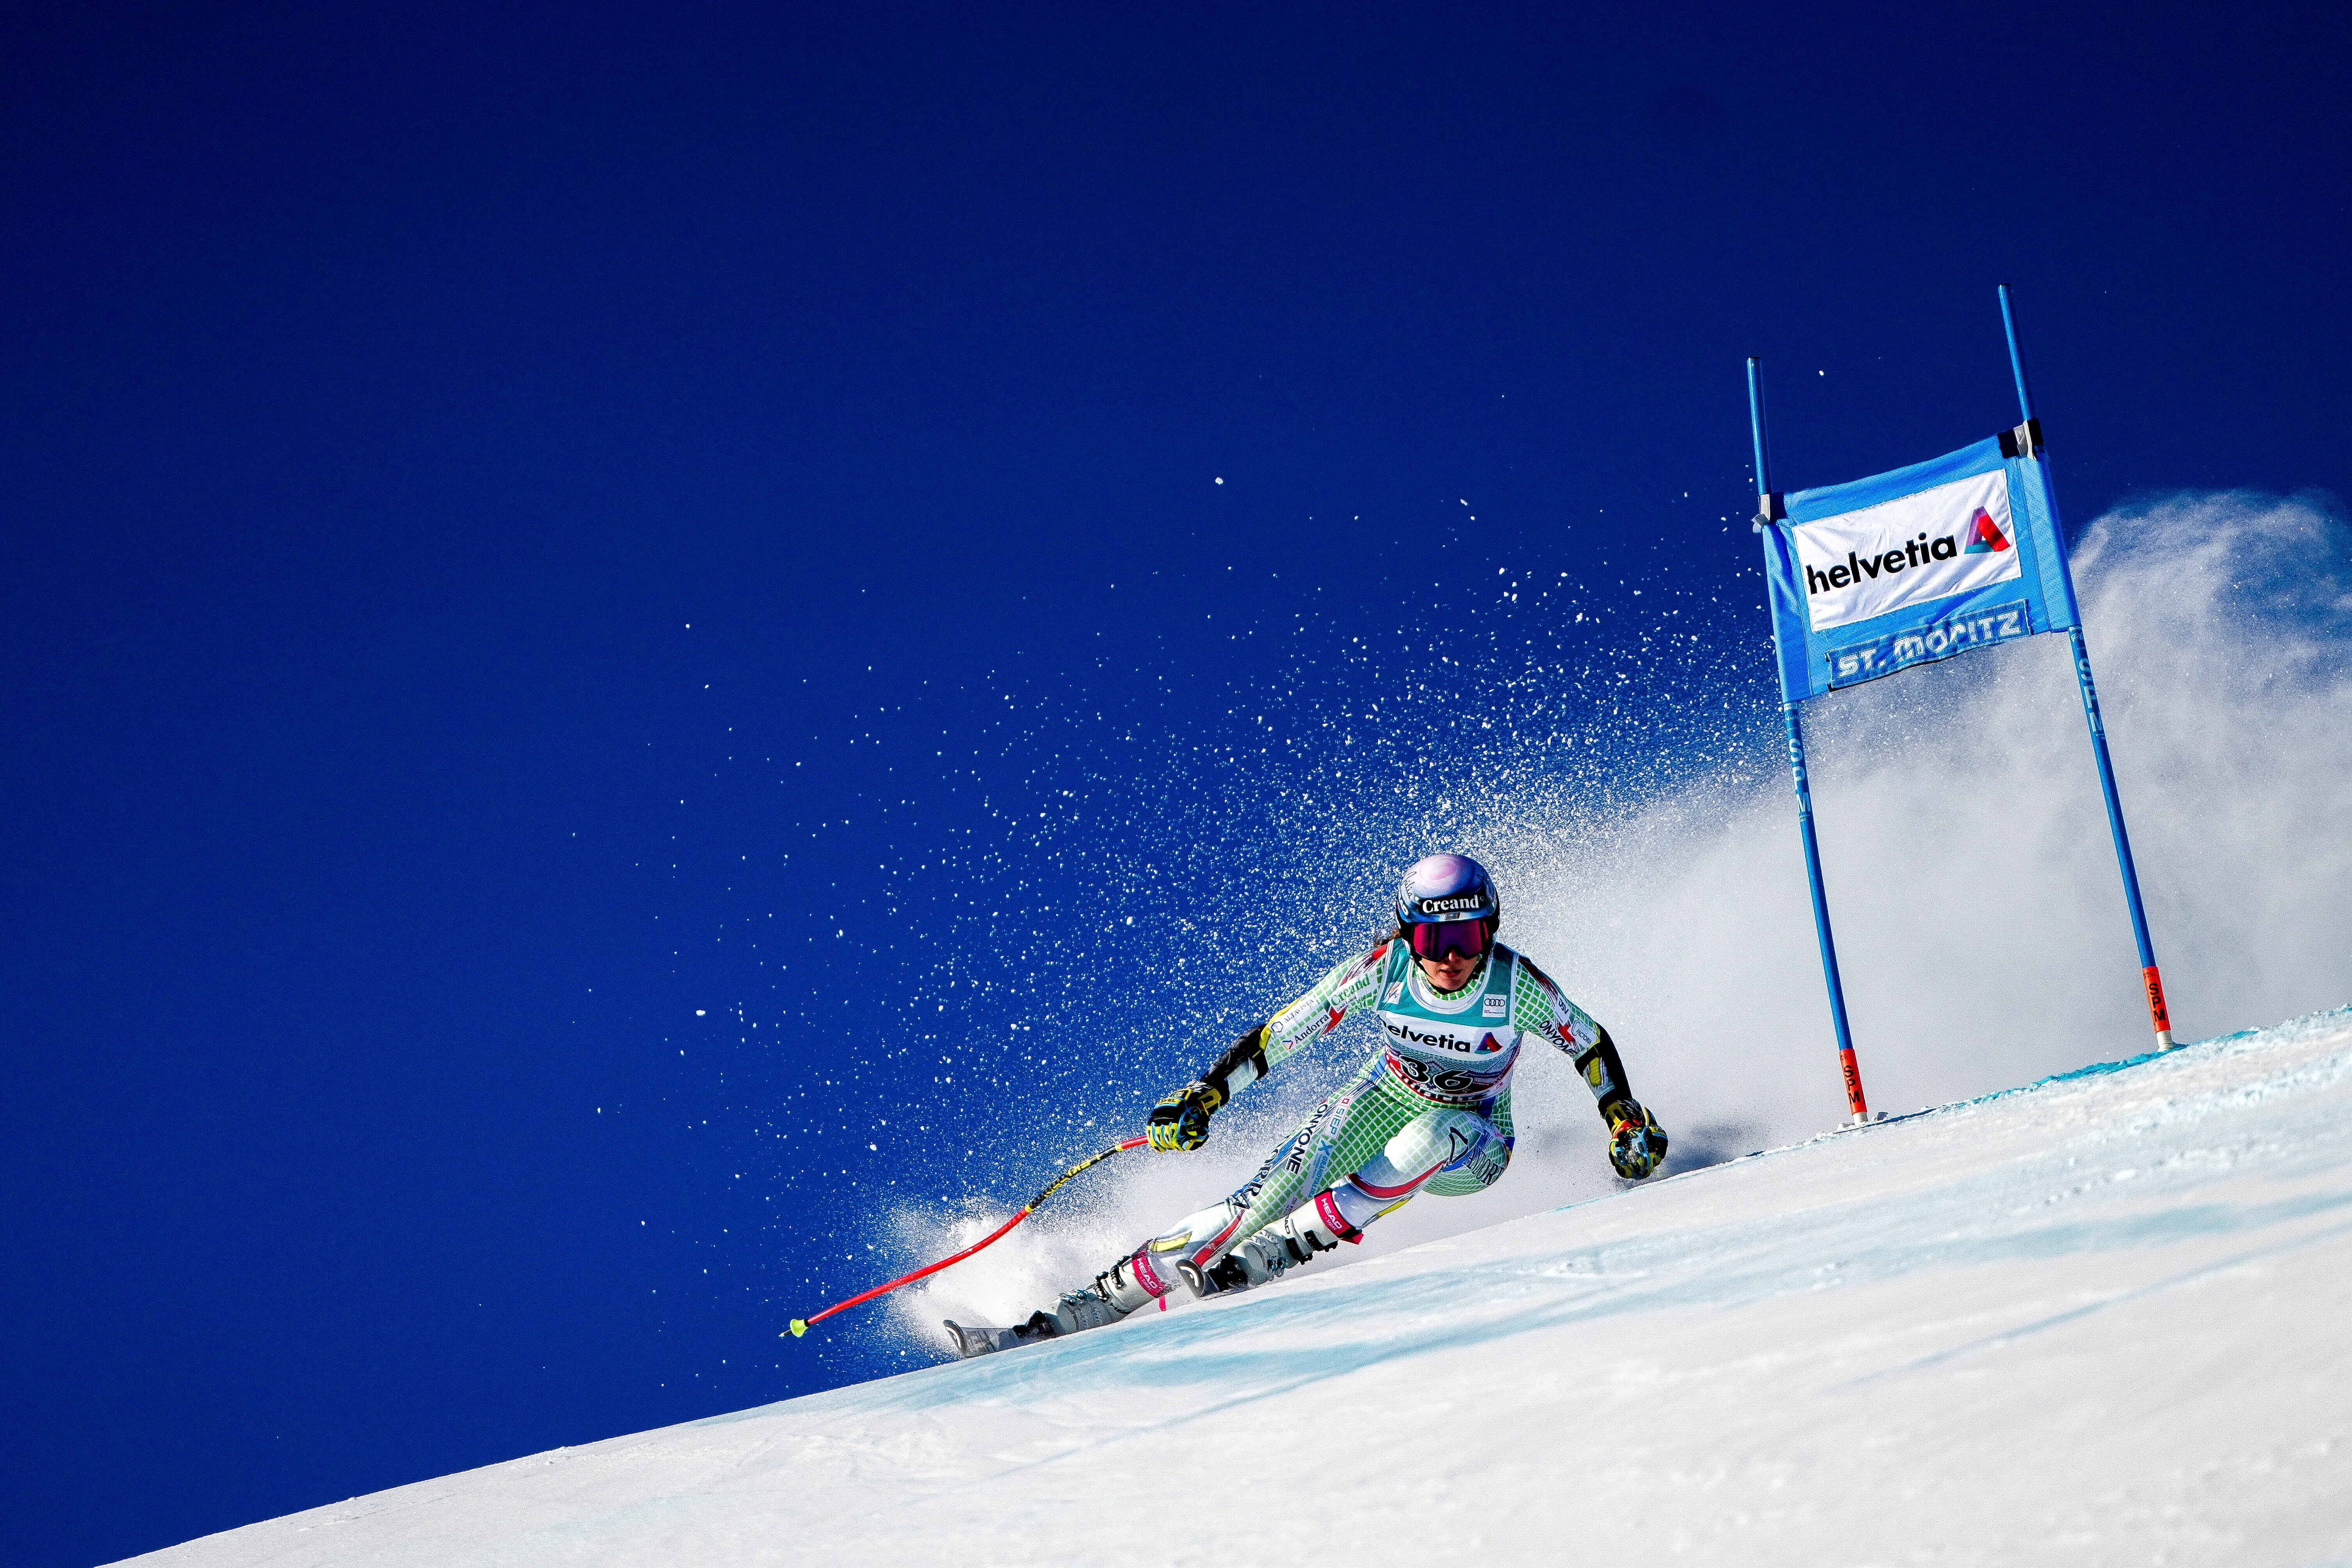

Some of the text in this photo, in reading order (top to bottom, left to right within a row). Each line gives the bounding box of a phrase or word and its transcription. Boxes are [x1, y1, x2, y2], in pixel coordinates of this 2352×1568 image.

[1806, 532, 1957, 595] helvetia
[1837, 647, 1886, 678] ST.
[1789, 738, 1811, 813] SPM
[1422, 895, 1479, 913] Creand
[1331, 973, 1371, 1006] Creand
[2149, 982, 2165, 1022] SPM
[1284, 998, 1314, 1023] ALTAVISTA
[1293, 1014, 1330, 1044] Andorra
[1399, 1054, 1473, 1091] 36
[1844, 1065, 1860, 1104] SPM
[1330, 1107, 1344, 1135] SIEP
[1321, 1198, 1342, 1229] HEAD
[1137, 1258, 1158, 1289] HEAD
